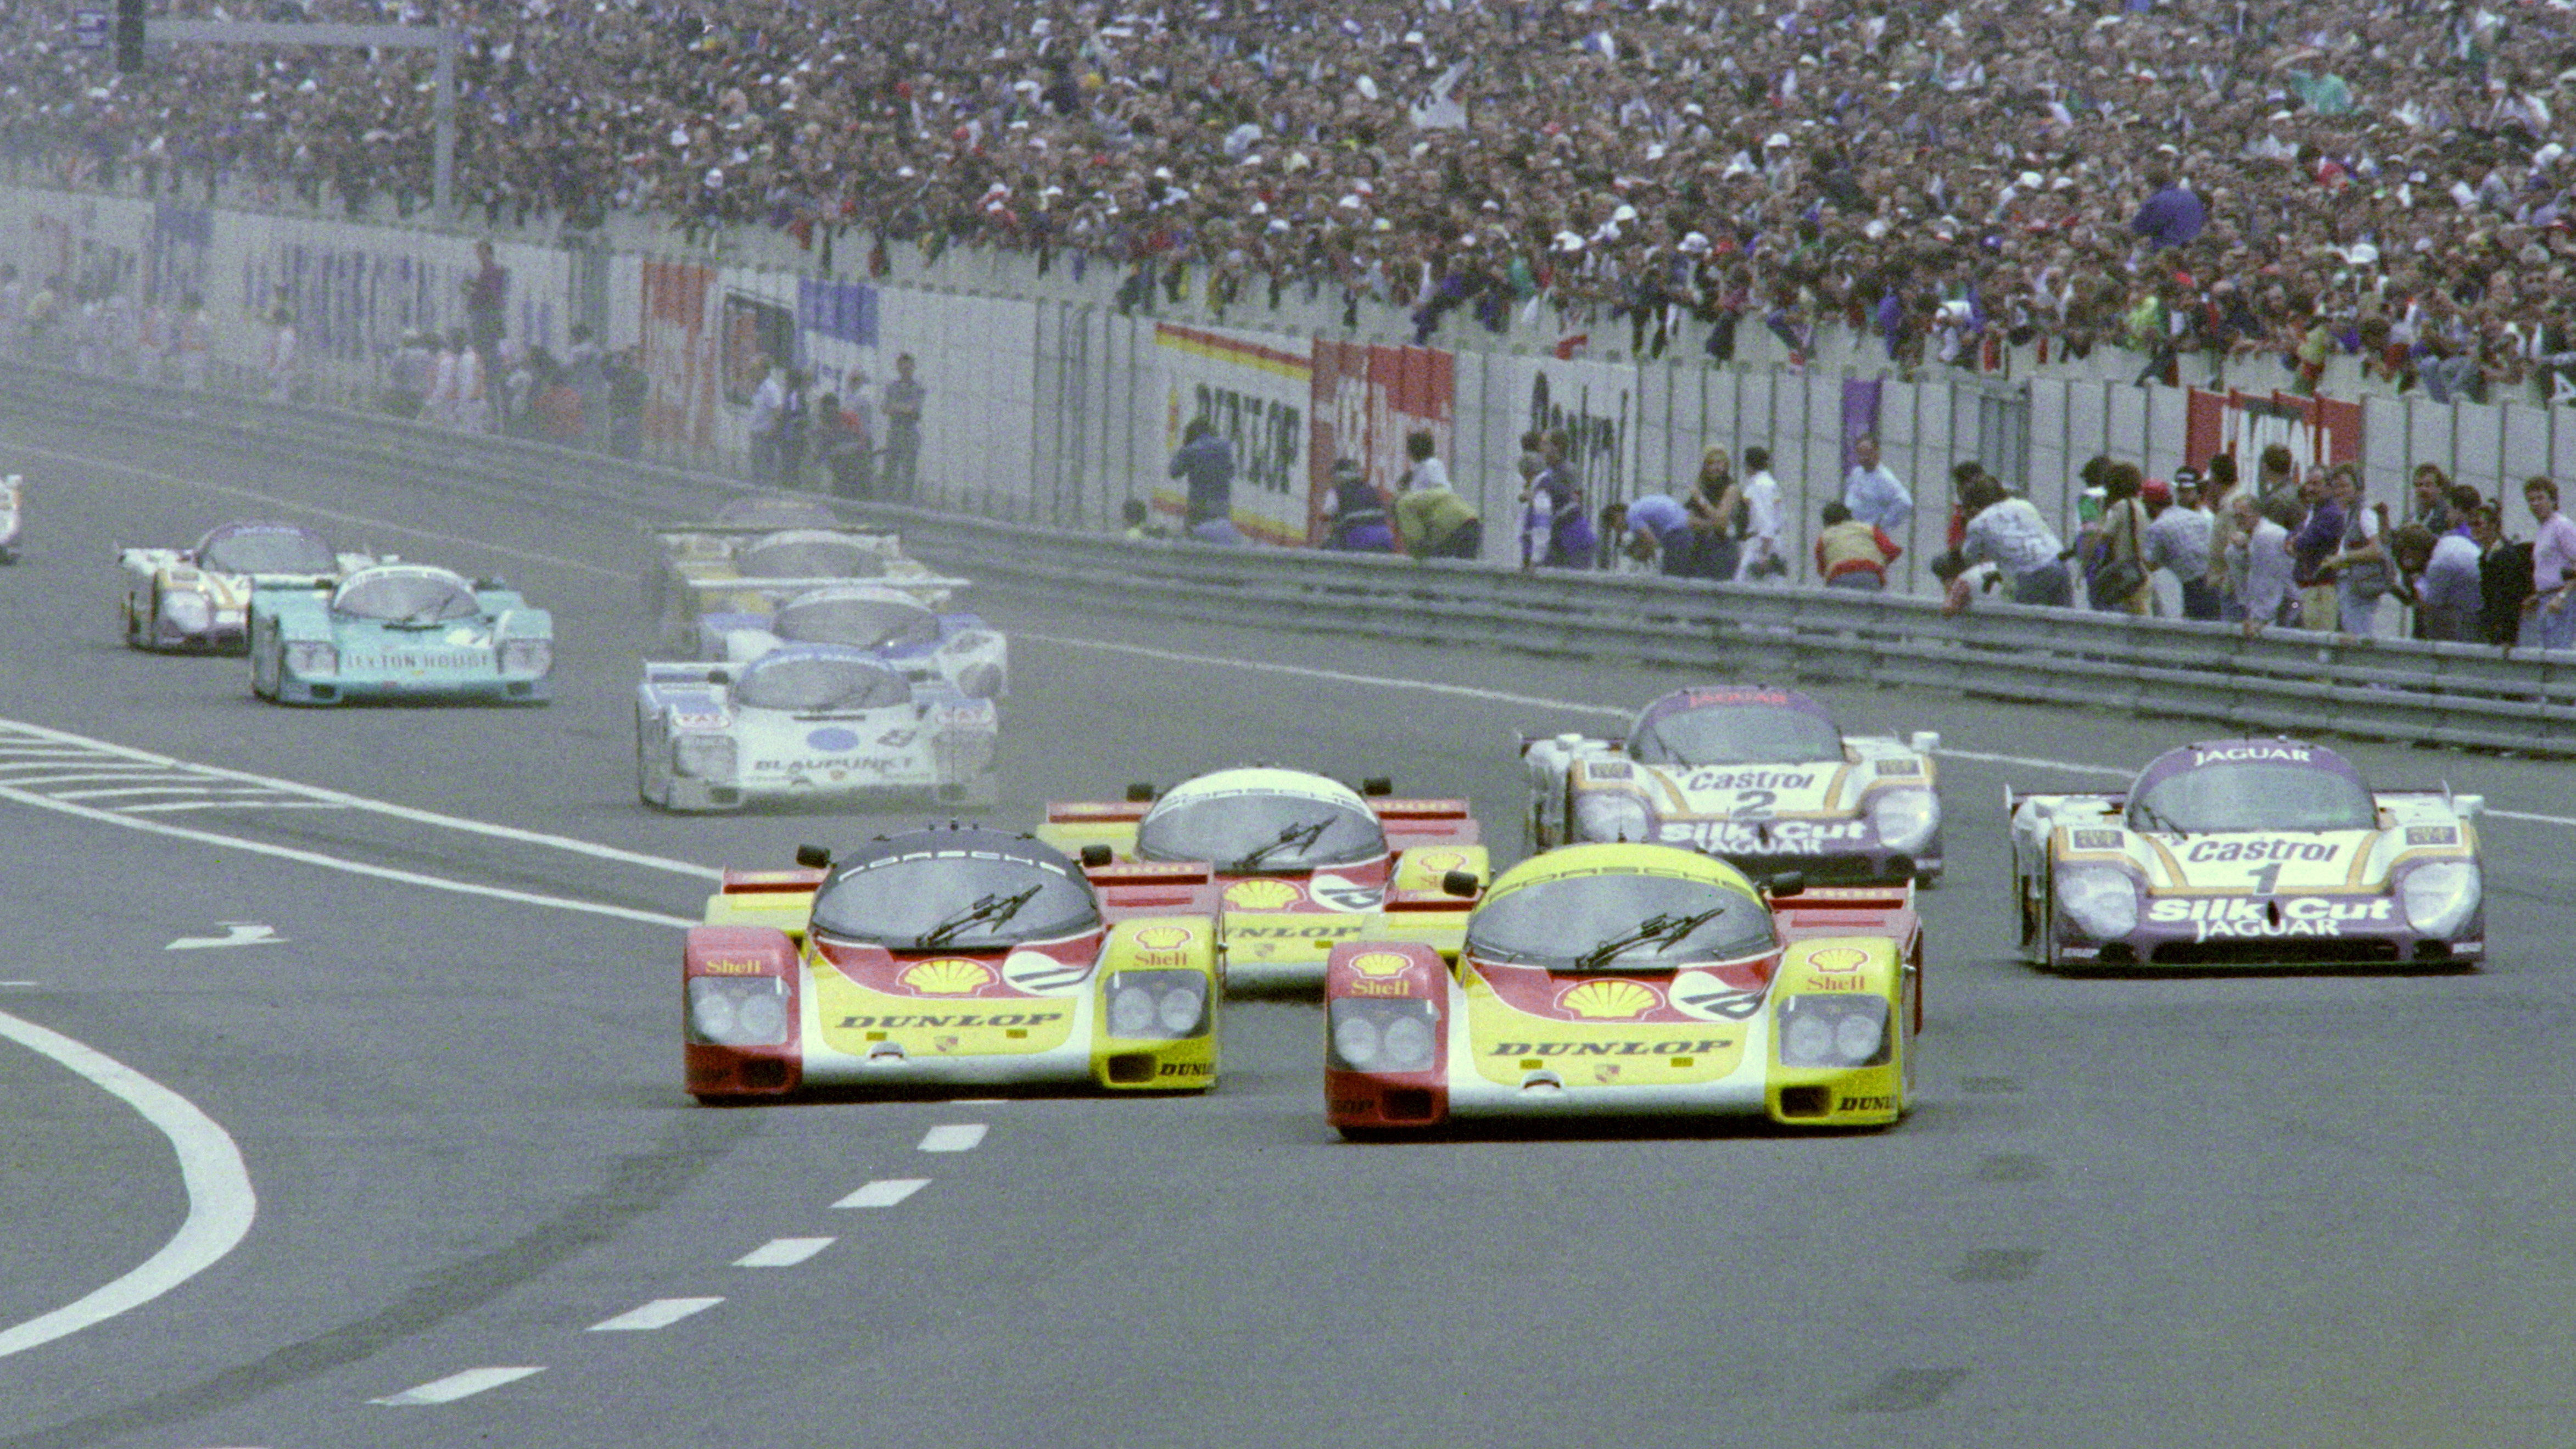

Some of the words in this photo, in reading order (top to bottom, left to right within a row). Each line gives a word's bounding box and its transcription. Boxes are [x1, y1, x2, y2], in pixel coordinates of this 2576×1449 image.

[754, 756, 914, 773] BLAUPUNKT
[2194, 747, 2311, 766] JAGUAR
[1687, 771, 1815, 791] Castrol
[1730, 791, 1777, 820] 2
[1659, 823, 1759, 841] Silk
[1774, 820, 1868, 840] Cut
[1695, 838, 1823, 854] JAGUAR
[2188, 839, 2339, 863] Castrol
[2247, 863, 2282, 895] 1
[2149, 898, 2265, 921] Silk
[2287, 897, 2393, 921] Cut
[2195, 920, 2339, 943] JAGUAR
[707, 959, 761, 974] Shell
[1133, 951, 1187, 967] Shell
[1351, 979, 1409, 996] Shell
[1807, 974, 1864, 991] Shell
[838, 1013, 1063, 1028] DUNLOP
[1490, 1039, 1732, 1055] DUNLOP
